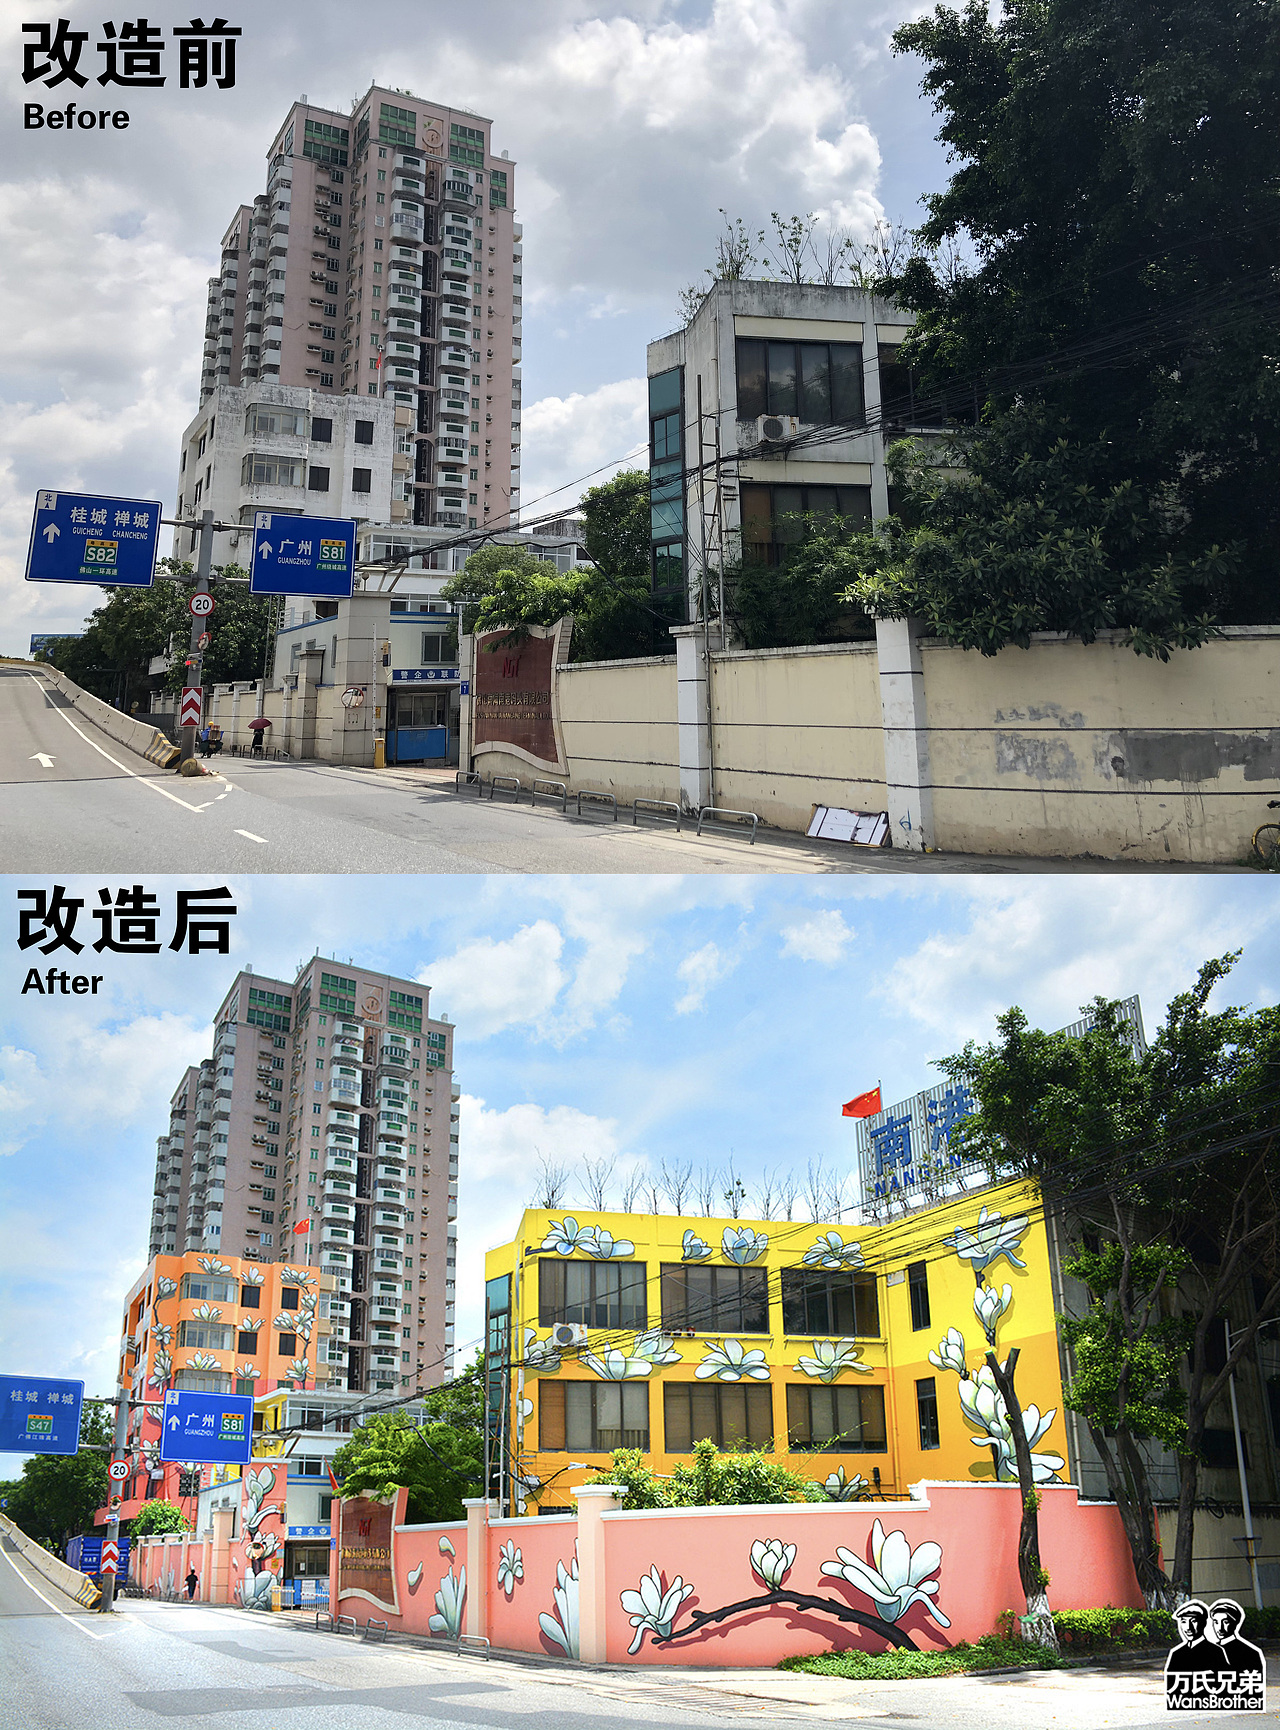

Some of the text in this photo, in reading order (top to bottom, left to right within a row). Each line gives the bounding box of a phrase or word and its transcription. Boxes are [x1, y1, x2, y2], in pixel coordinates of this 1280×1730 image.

[70, 506, 150, 529] 桂城 禅城
[72, 526, 148, 540] GUICHENG CHANCHENG
[278, 538, 312, 556] 广州
[322, 546, 344, 560] S81
[86, 547, 116, 563] S82
[277, 556, 312, 566] GUANGZHOU
[195, 600, 209, 610] 20
[10, 1389, 74, 1405] 桂城 禅城
[29, 1420, 49, 1431] S47
[185, 1412, 215, 1428] 广州
[223, 1419, 242, 1431] S81
[113, 1466, 126, 1475] 20
